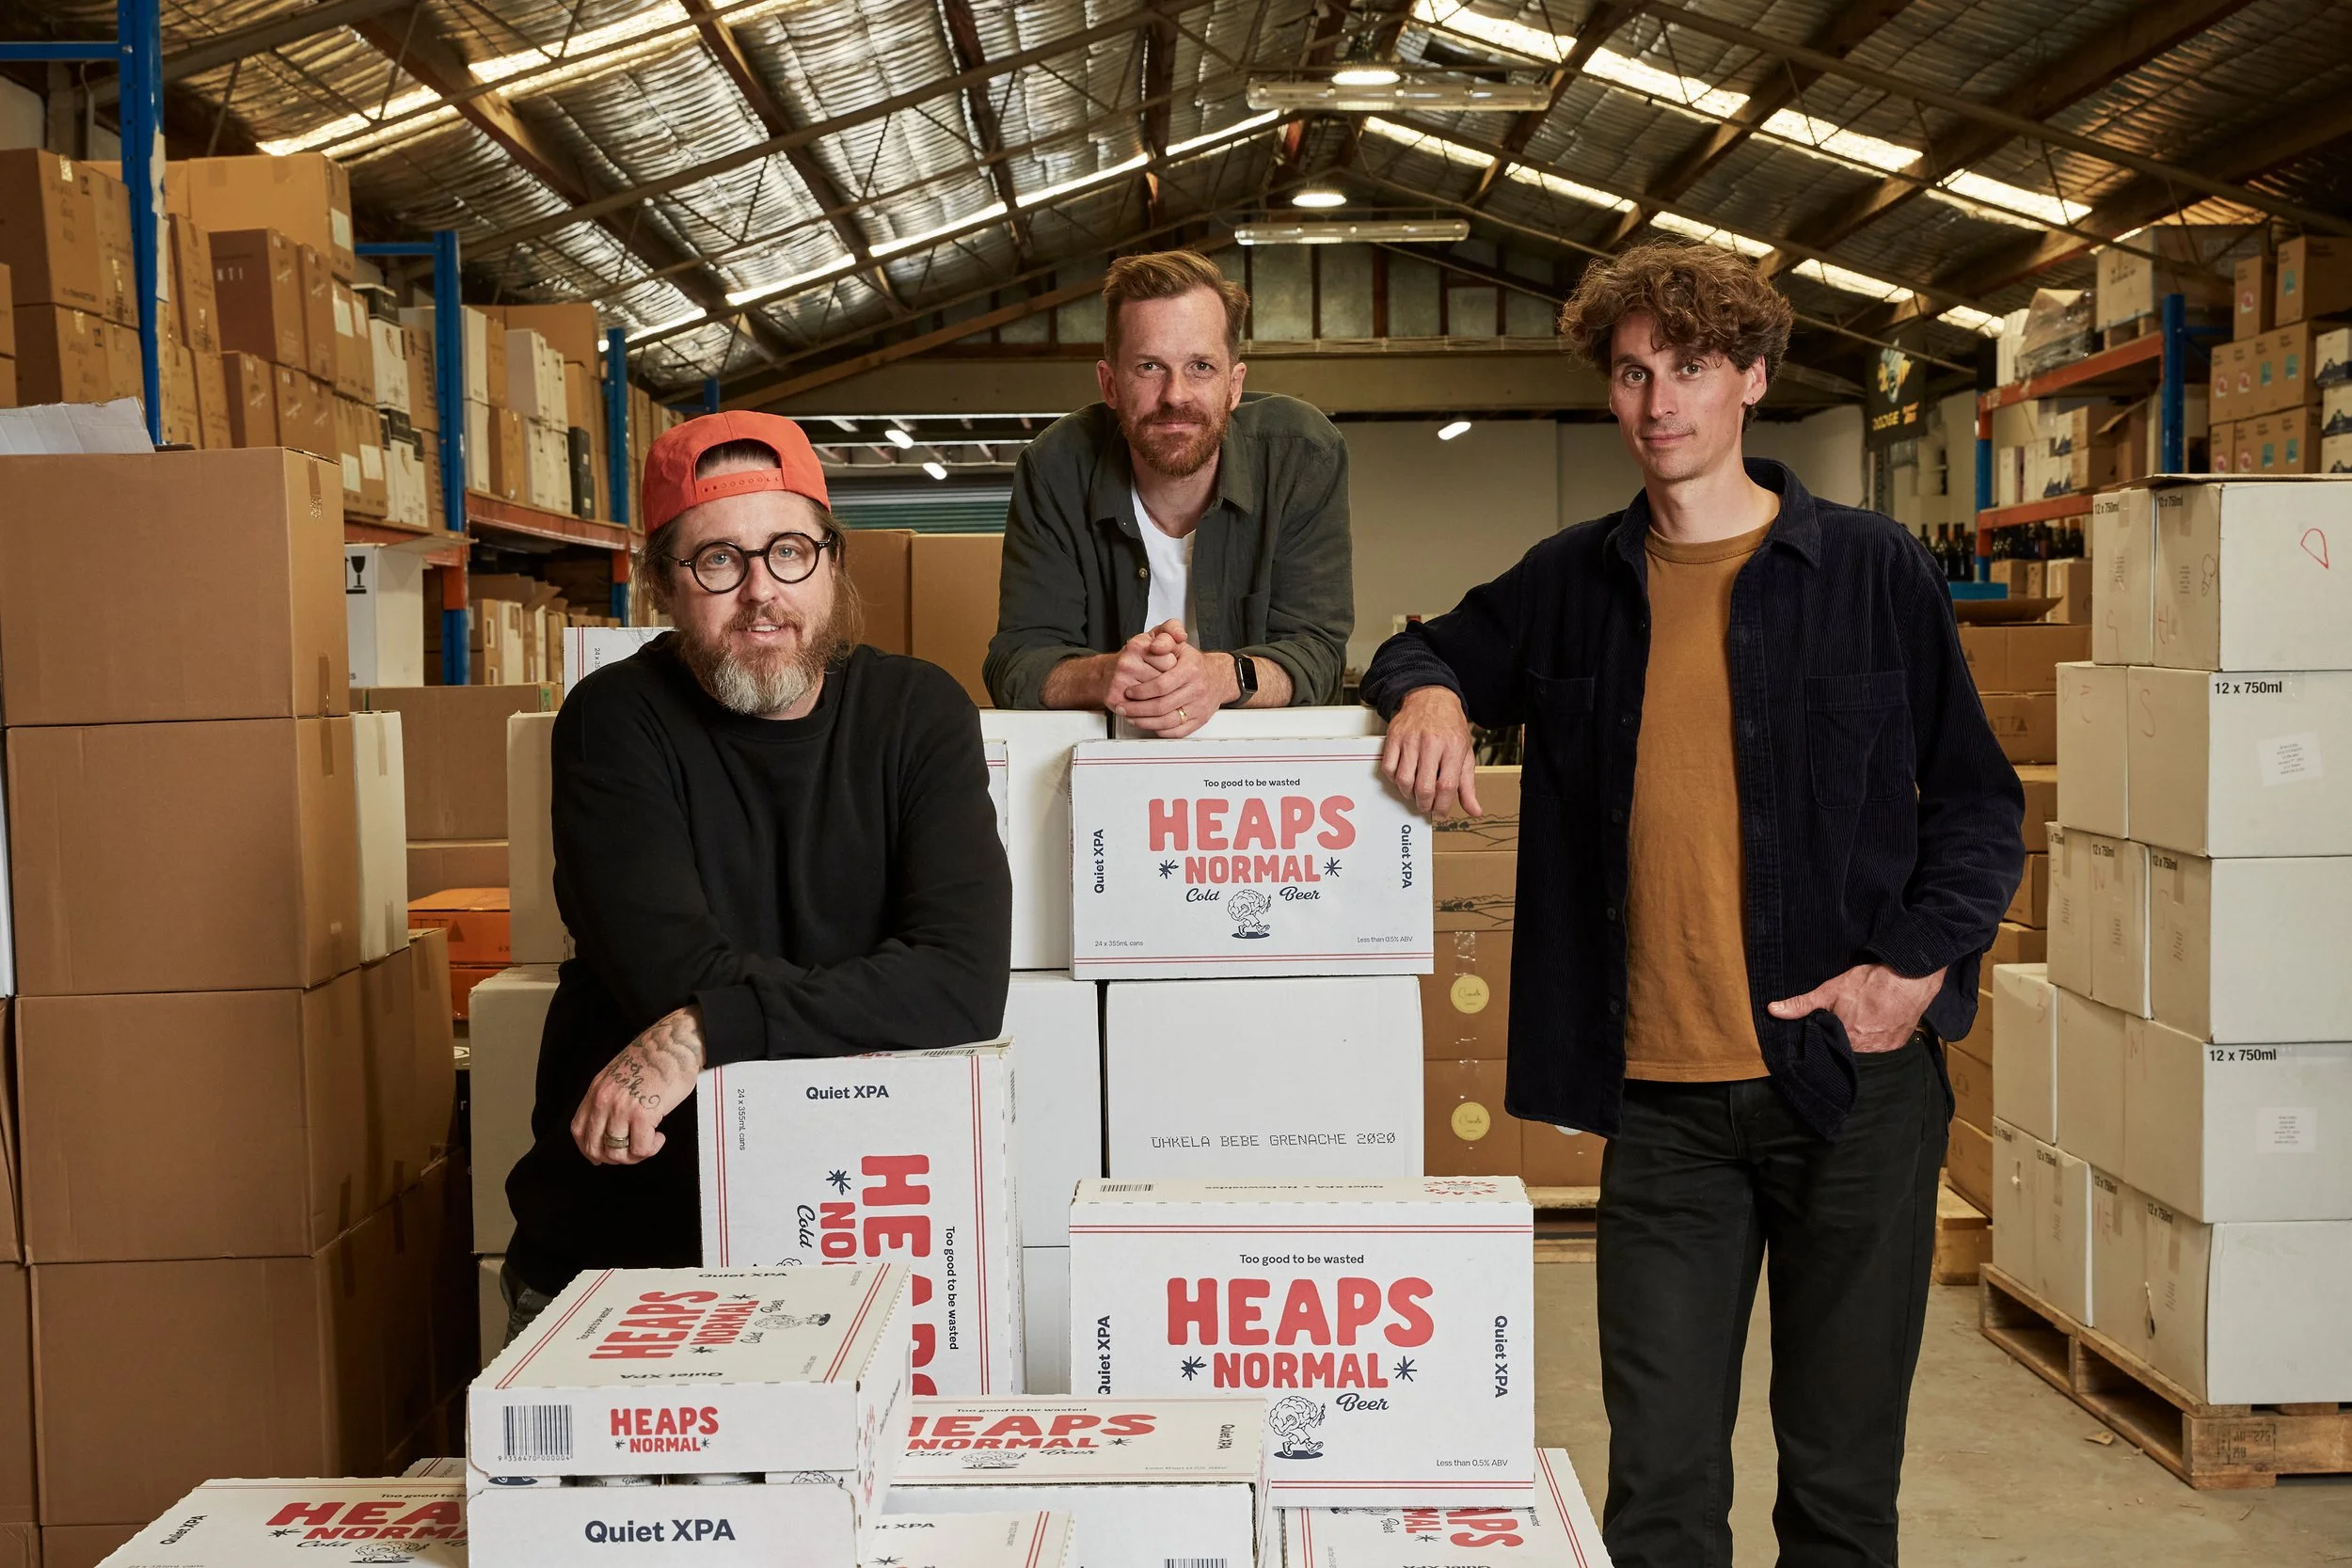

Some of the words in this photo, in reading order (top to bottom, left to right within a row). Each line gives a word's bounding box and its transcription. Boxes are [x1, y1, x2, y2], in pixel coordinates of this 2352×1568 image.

[2215, 683, 2229, 694] 12
[2233, 685, 2240, 694] x
[2244, 681, 2282, 694] 750ml
[1203, 779, 1219, 787] Too
[1221, 779, 1243, 789] good
[1245, 779, 1254, 787] to
[1268, 778, 1300, 786] wasted
[1148, 795, 1356, 851] HEAPS
[1093, 829, 1104, 857] XPA
[1401, 824, 1412, 859] Quiet
[1094, 859, 1104, 894] Quiet
[1184, 854, 1321, 884] NORMAL
[1402, 861, 1412, 889] XPA
[1185, 888, 1220, 903] Cold
[1279, 886, 1321, 902] Beer
[2209, 1050, 2224, 1061] 12
[2228, 1052, 2235, 1061] x
[2238, 1049, 2277, 1061] 750ml
[738, 1088, 745, 1100] 24
[805, 1085, 850, 1101] Quiet
[852, 1085, 890, 1099] XPA
[738, 1105, 746, 1132] 355mL
[1220, 1135, 1260, 1147] BEBE
[1269, 1133, 1346, 1147] GRENACHE
[797, 1204, 816, 1249] Cold
[946, 1227, 955, 1246] Too
[944, 1248, 957, 1276] good
[1239, 1254, 1259, 1264] Too
[1262, 1254, 1290, 1266] good
[1292, 1255, 1305, 1264] to
[1307, 1254, 1321, 1264] be
[1323, 1254, 1364, 1264] wasted
[946, 1279, 957, 1291] to
[947, 1293, 957, 1307] be
[1167, 1276, 1435, 1347] HEAPS
[588, 1291, 718, 1359] HEAPS
[690, 1301, 759, 1345] NORMAL
[948, 1308, 959, 1350] wasted
[1097, 1315, 1110, 1351] XPA
[1494, 1315, 1508, 1359] Quiet
[1097, 1354, 1111, 1395] Quiet
[1213, 1352, 1388, 1388] NORMAL
[1495, 1363, 1508, 1399] XPA
[1336, 1393, 1390, 1412] Beer
[610, 1406, 719, 1436] HEAPS
[629, 1436, 701, 1453] NORMAL
[906, 1438, 1099, 1449] NORMAL
[184, 1514, 208, 1530] XPA
[265, 1501, 461, 1526] HEA
[585, 1520, 665, 1544] Quiet
[671, 1519, 736, 1542] XPA
